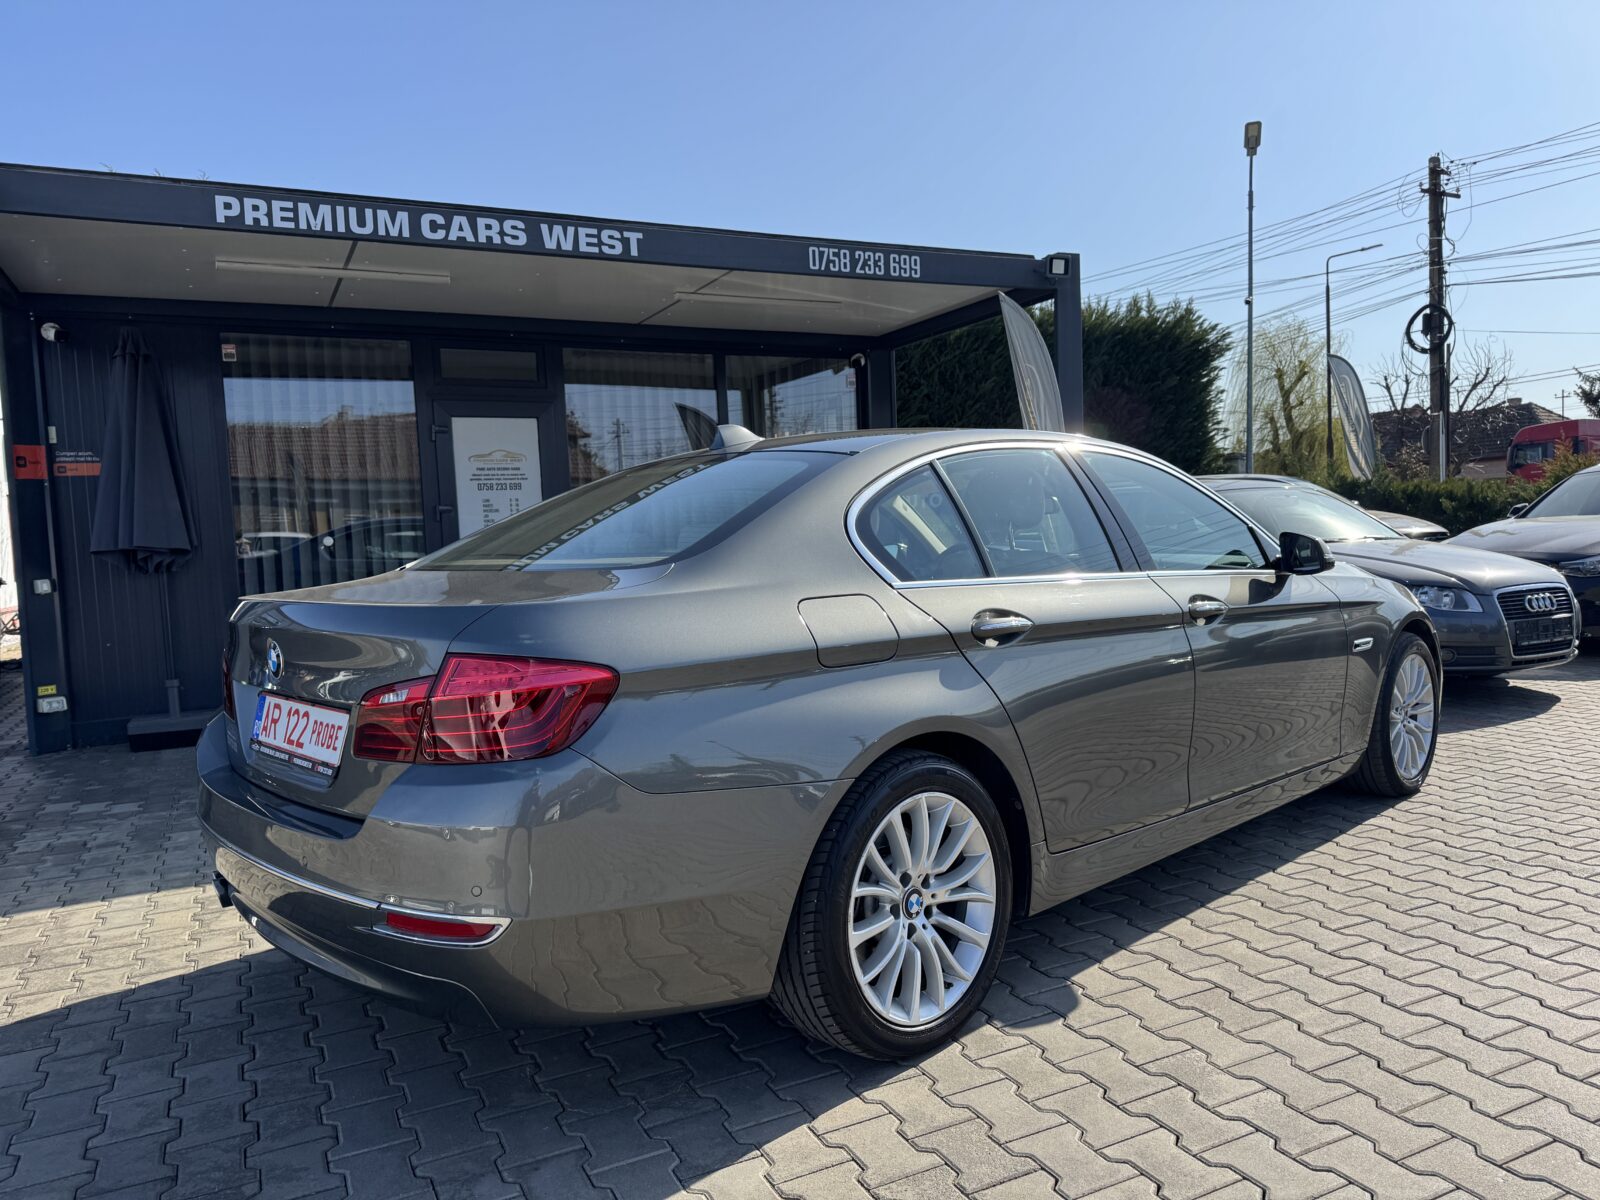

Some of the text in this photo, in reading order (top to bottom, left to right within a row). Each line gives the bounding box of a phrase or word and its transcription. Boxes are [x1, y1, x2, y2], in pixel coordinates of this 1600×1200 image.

[214, 194, 643, 257] PREMIUM CARS WEST
[808, 246, 921, 279] 0758 233 699
[477, 483, 522, 491] 0758 233 699
[261, 702, 281, 740] AR
[283, 706, 310, 749] 122
[309, 719, 342, 751] PROBE
